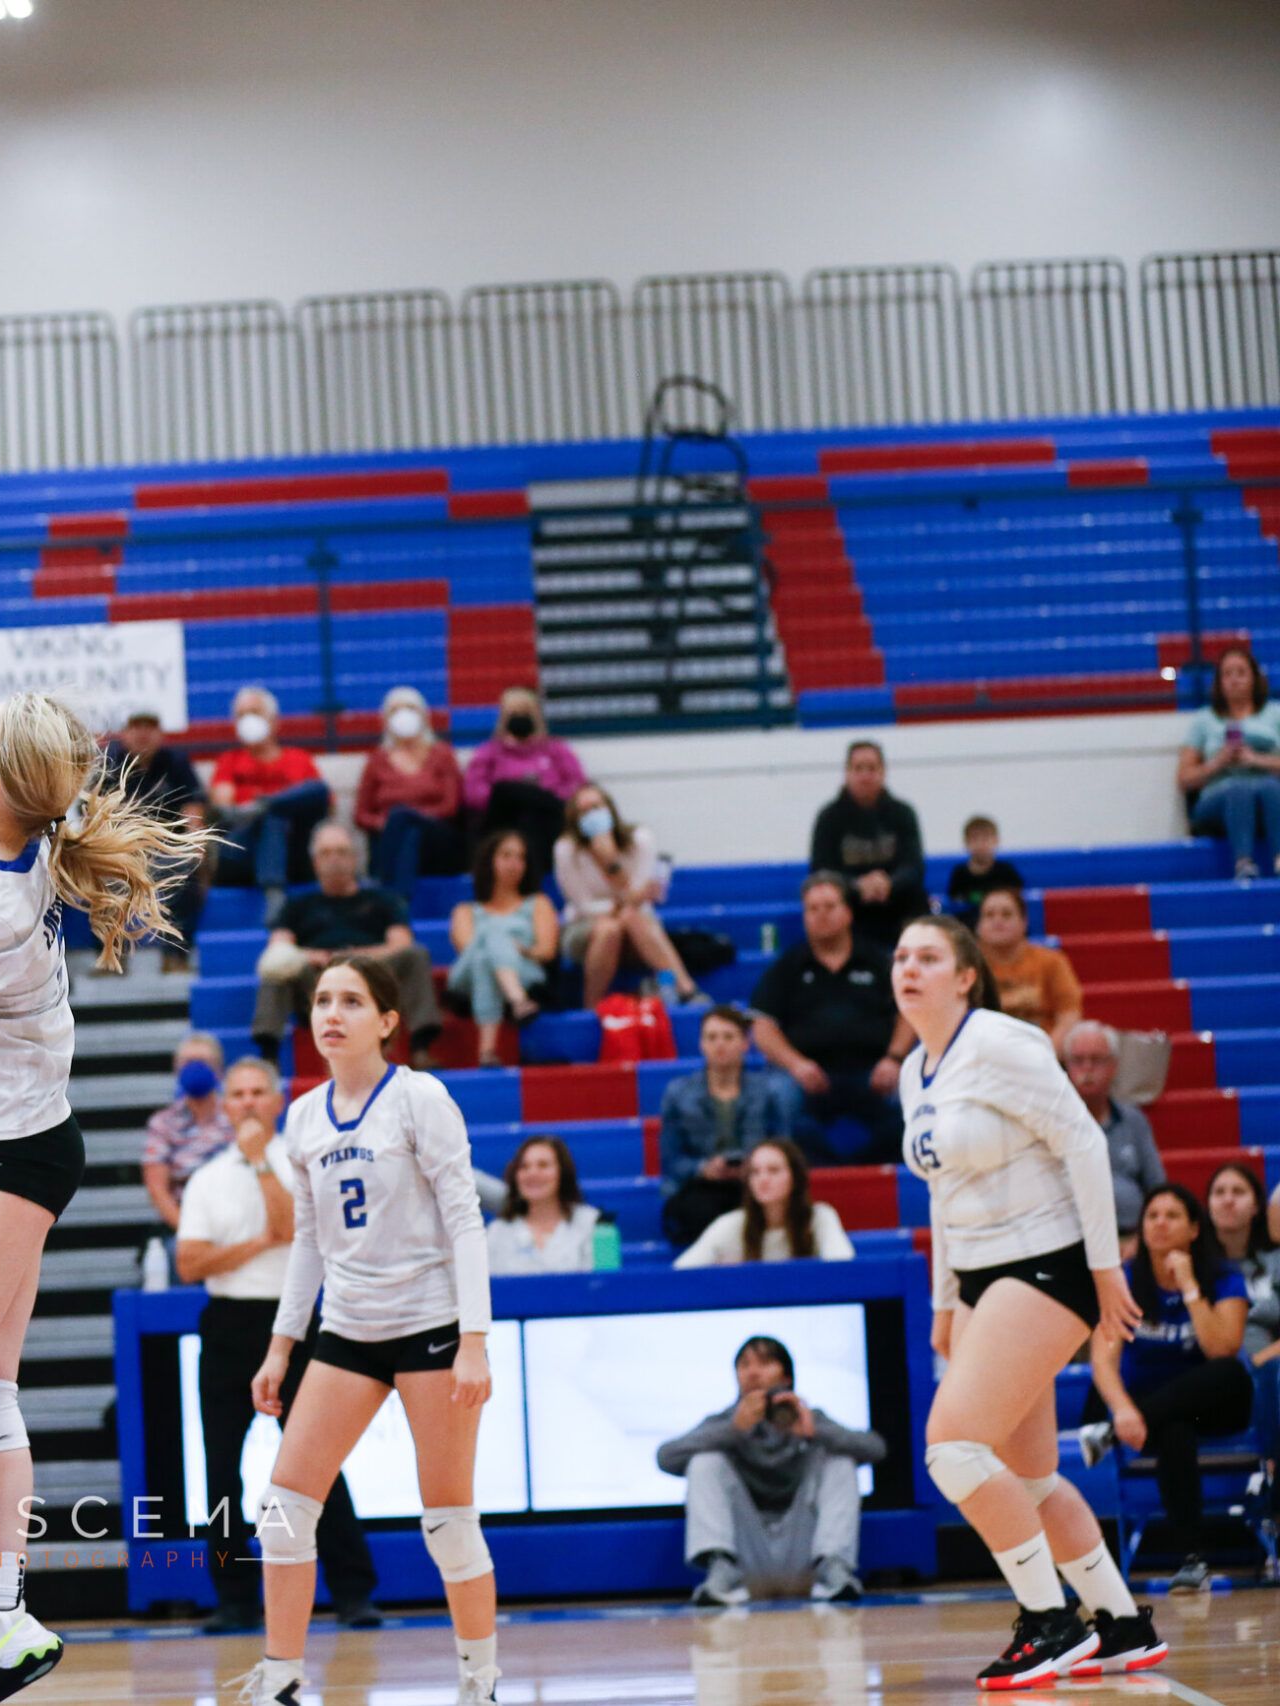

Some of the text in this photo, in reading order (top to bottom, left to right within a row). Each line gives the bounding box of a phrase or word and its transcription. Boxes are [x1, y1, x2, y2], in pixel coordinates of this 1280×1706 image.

[9, 630, 123, 658] VIKING
[319, 1146, 375, 1168] VIKINGS
[340, 1178, 367, 1229] 2
